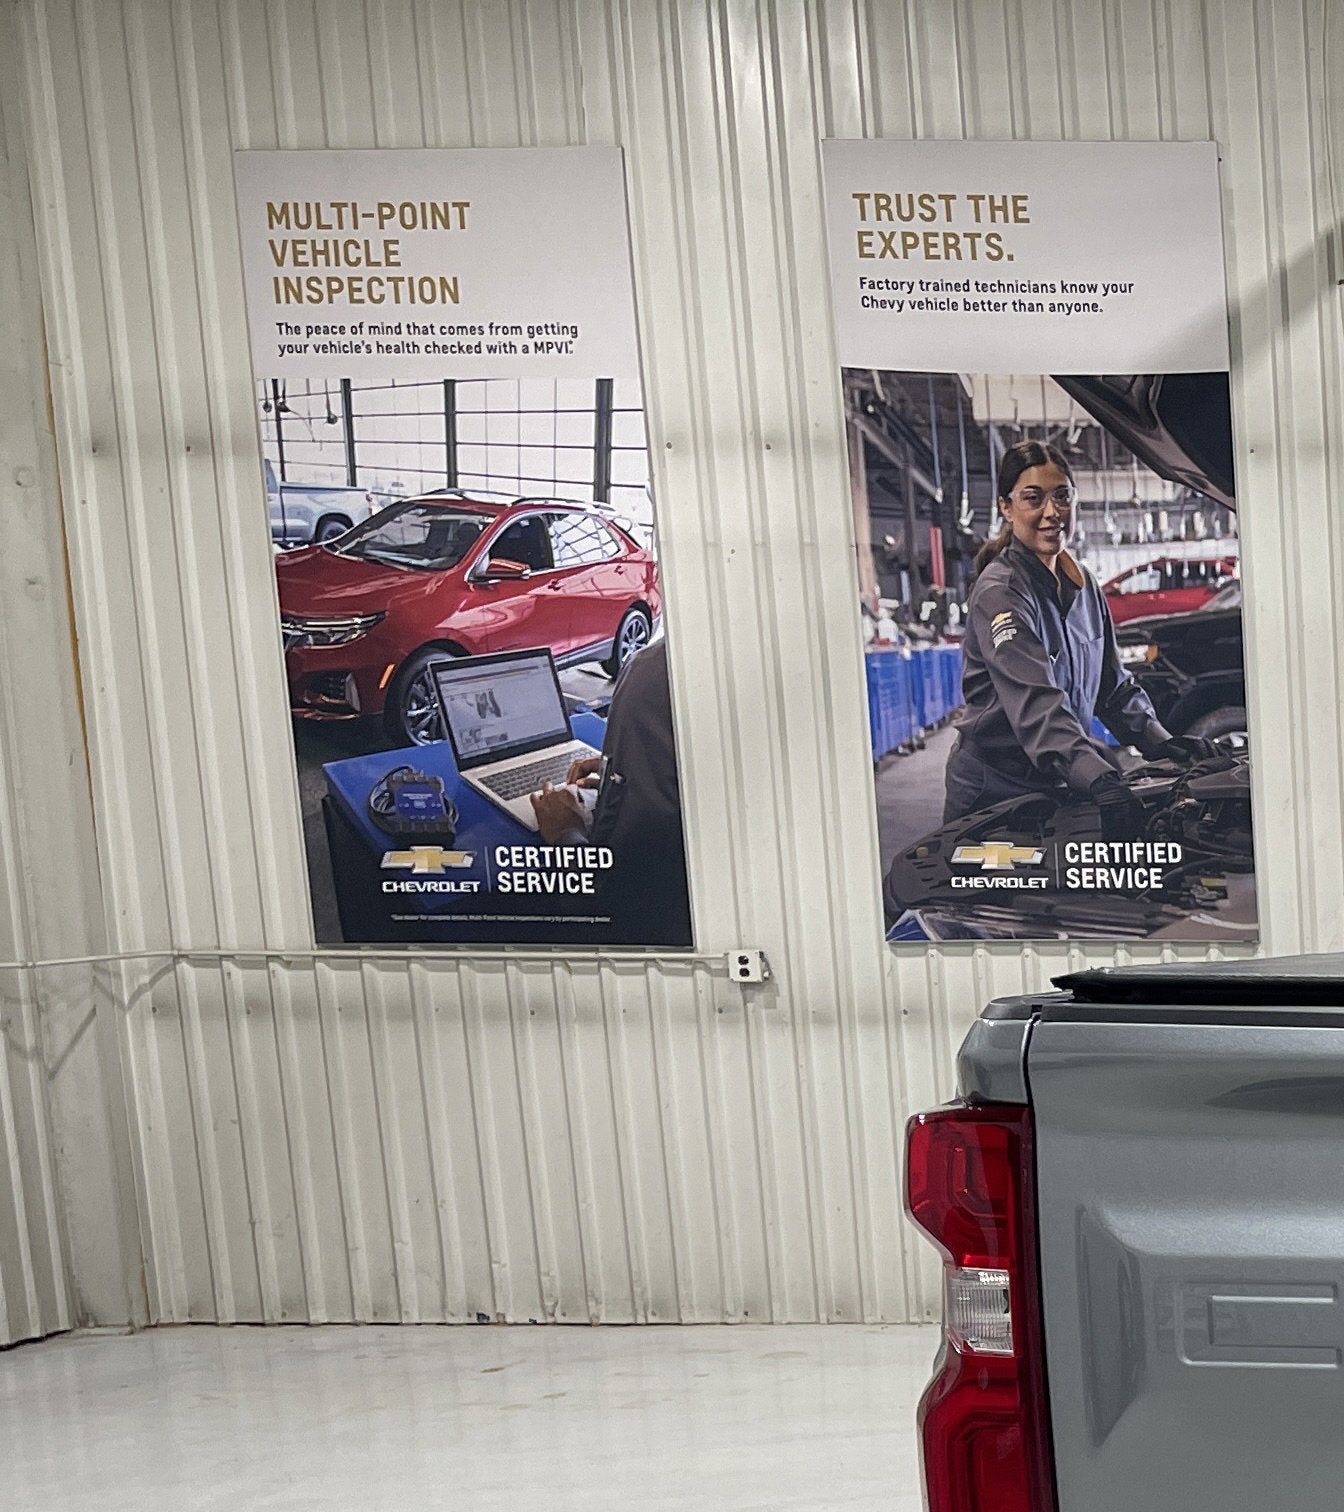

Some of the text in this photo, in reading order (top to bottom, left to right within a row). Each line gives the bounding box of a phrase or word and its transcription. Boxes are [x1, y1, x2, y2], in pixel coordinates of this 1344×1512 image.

[265, 201, 471, 230] MULTI-POINT
[852, 193, 1031, 224] TRUST THE
[268, 239, 401, 267] VEHICLE
[857, 231, 1014, 262] EXPERTS.
[273, 276, 460, 304] INSPECTION
[859, 276, 1135, 297] Factory trained technicians know your
[861, 295, 1104, 316] Chevy vehicle better than anyone.
[275, 322, 578, 339] The peace of mind that comes from getting
[277, 343, 309, 358] your
[313, 340, 372, 354] vehicle's
[376, 340, 420, 354] health
[424, 341, 482, 354] checked
[486, 341, 518, 354] with
[521, 344, 530, 354] a
[494, 846, 613, 869] CERTIFIED
[1064, 842, 1182, 864] CERTIFIED
[382, 880, 480, 893] CHEVROLET
[497, 872, 596, 895] SERVICE
[951, 877, 1049, 889] CHEVROLET
[1066, 867, 1164, 889] SERVICE
